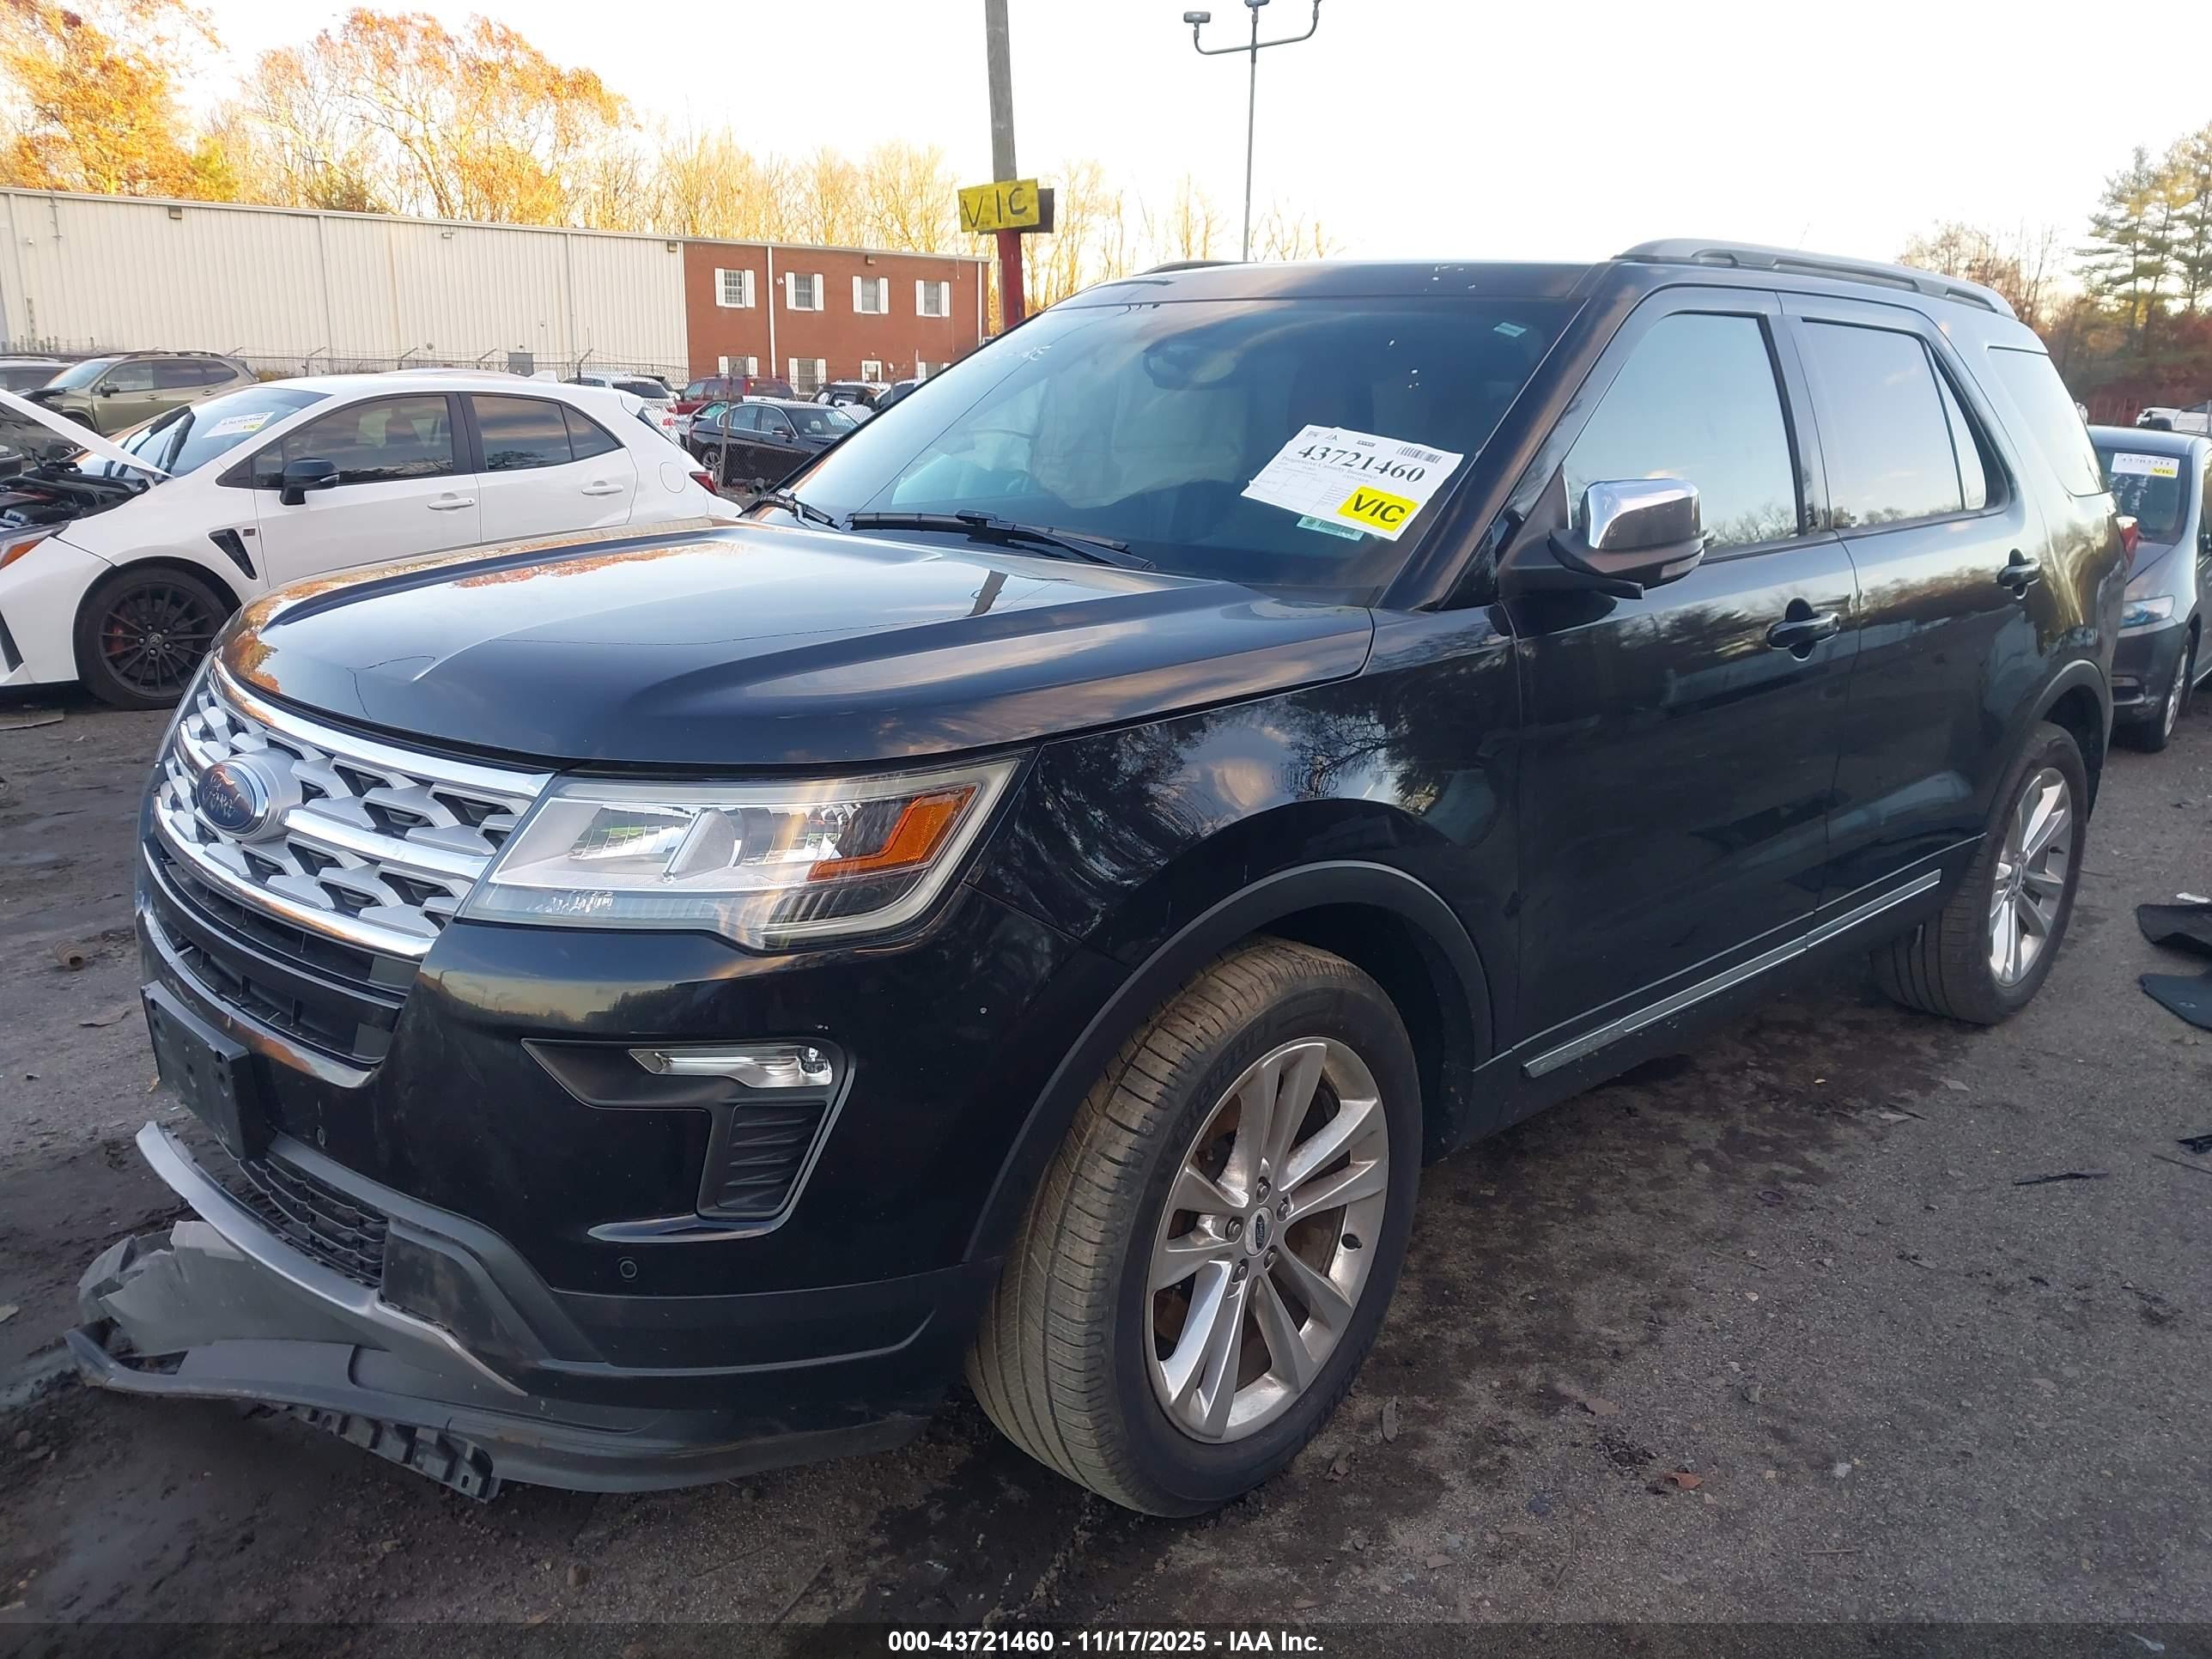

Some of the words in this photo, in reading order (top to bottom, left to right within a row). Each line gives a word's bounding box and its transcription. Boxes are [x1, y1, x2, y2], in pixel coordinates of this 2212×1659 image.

[963, 186, 1028, 228] VIC
[1297, 444, 1425, 483] 43721460
[1352, 494, 1405, 523] VIC
